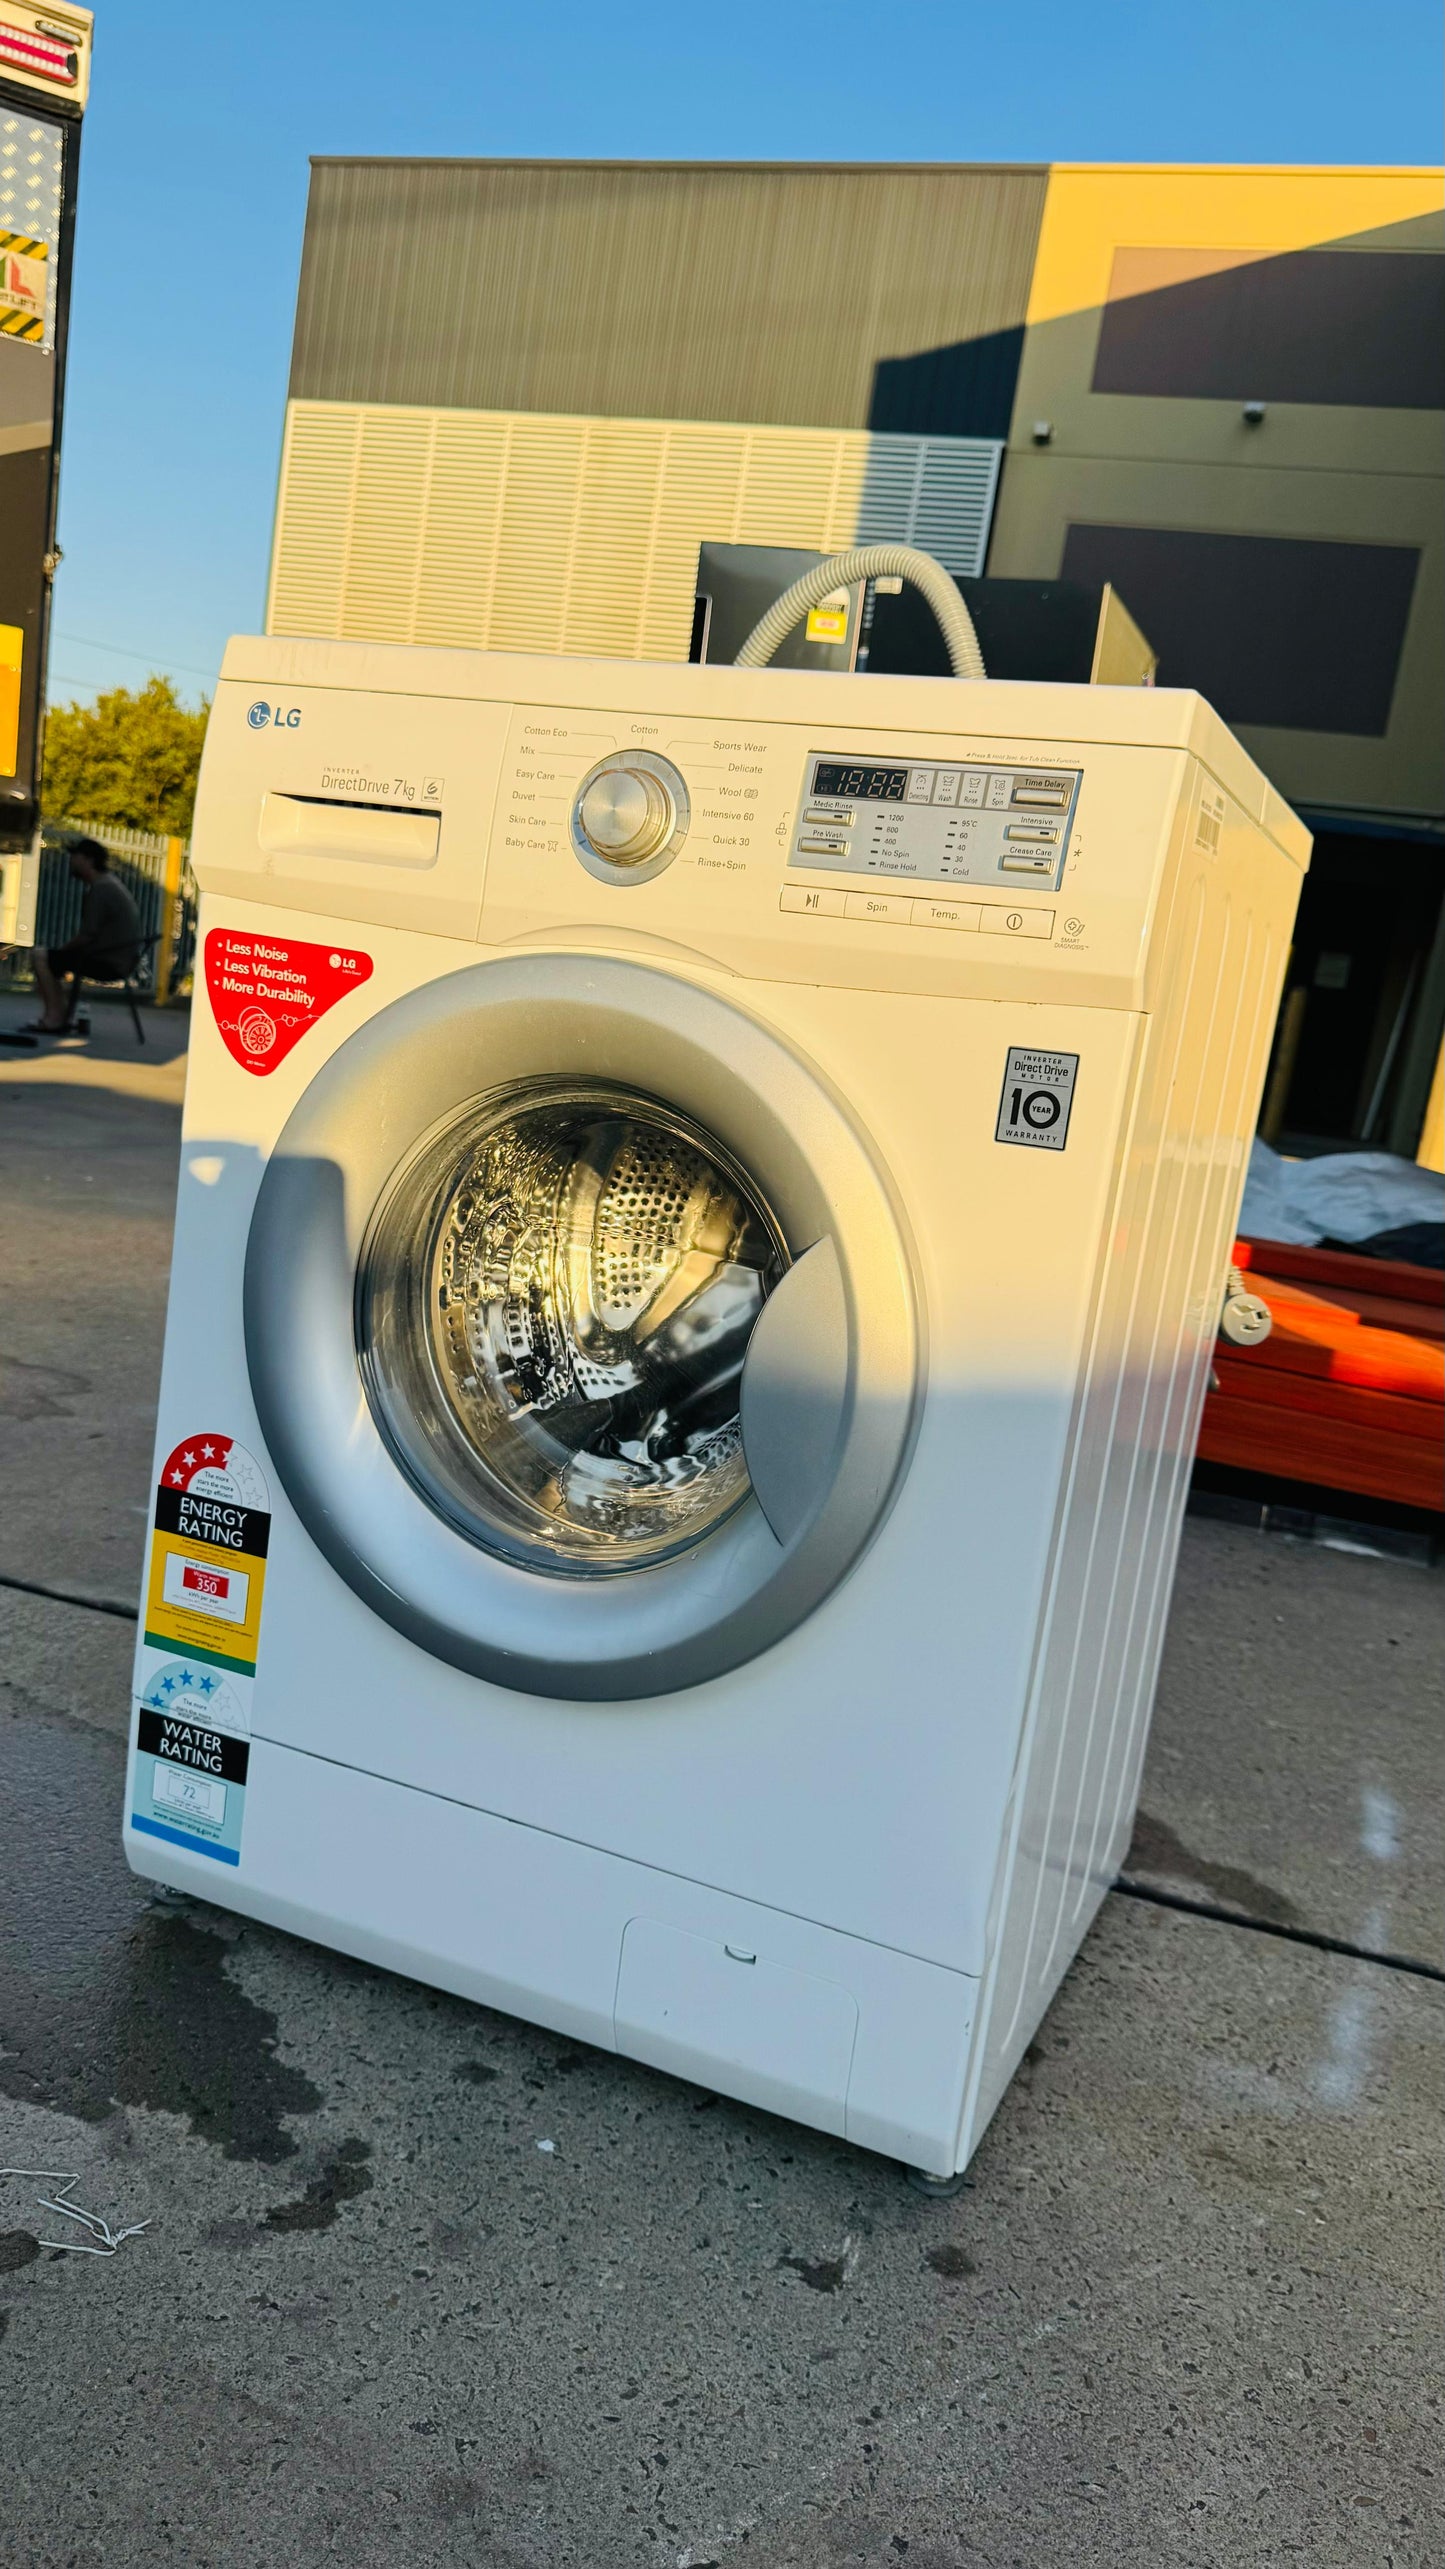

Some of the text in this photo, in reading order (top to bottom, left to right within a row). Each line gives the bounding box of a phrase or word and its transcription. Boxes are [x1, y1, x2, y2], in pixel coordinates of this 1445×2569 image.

[274, 707, 302, 728] LG
[524, 726, 568, 737] Cotton Eco
[631, 725, 658, 735] Cotton
[520, 746, 535, 756] Mix
[713, 741, 768, 752] Sports Wear
[728, 763, 763, 774] Delicate
[516, 770, 554, 780] Easy Care
[394, 778, 415, 800] 7kg
[1044, 780, 1066, 788] Delay
[512, 791, 536, 801] Duvet
[719, 787, 742, 797] Wool
[814, 800, 834, 808] Medic
[992, 798, 1004, 806] Spin
[508, 815, 546, 826] Skin Care
[702, 809, 754, 822] Intensive 60
[889, 814, 904, 822] 1200
[1020, 816, 1053, 825] Intensive
[712, 835, 750, 846] Quick 30
[960, 832, 968, 840] 60
[506, 838, 546, 850] Baby Care
[894, 850, 910, 858] Spin
[1010, 846, 1052, 856] Crease Care
[698, 858, 746, 870] Rinse+Spin
[880, 861, 916, 871] Rinse Hold
[952, 868, 969, 876] Cold
[866, 902, 888, 914] Spin
[931, 908, 960, 921] Temp.
[226, 939, 288, 962] Less Noise
[342, 958, 356, 969] LG
[224, 958, 306, 984] Less Vibration
[222, 977, 315, 1008] More Durability
[1024, 1055, 1062, 1064] INVERTER
[1014, 1061, 1068, 1076] Direct Drive
[1022, 1073, 1059, 1082] MOTOR
[1010, 1088, 1060, 1129] 10
[1032, 1105, 1052, 1114] YEAR
[1006, 1130, 1058, 1142] WARRANTY
[180, 1497, 248, 1528] ENERGY
[178, 1516, 244, 1548] RATING
[197, 1578, 217, 1594] 350
[164, 1720, 222, 1754] WATER
[160, 1738, 222, 1772] RATING
[184, 1784, 196, 1800] 72
